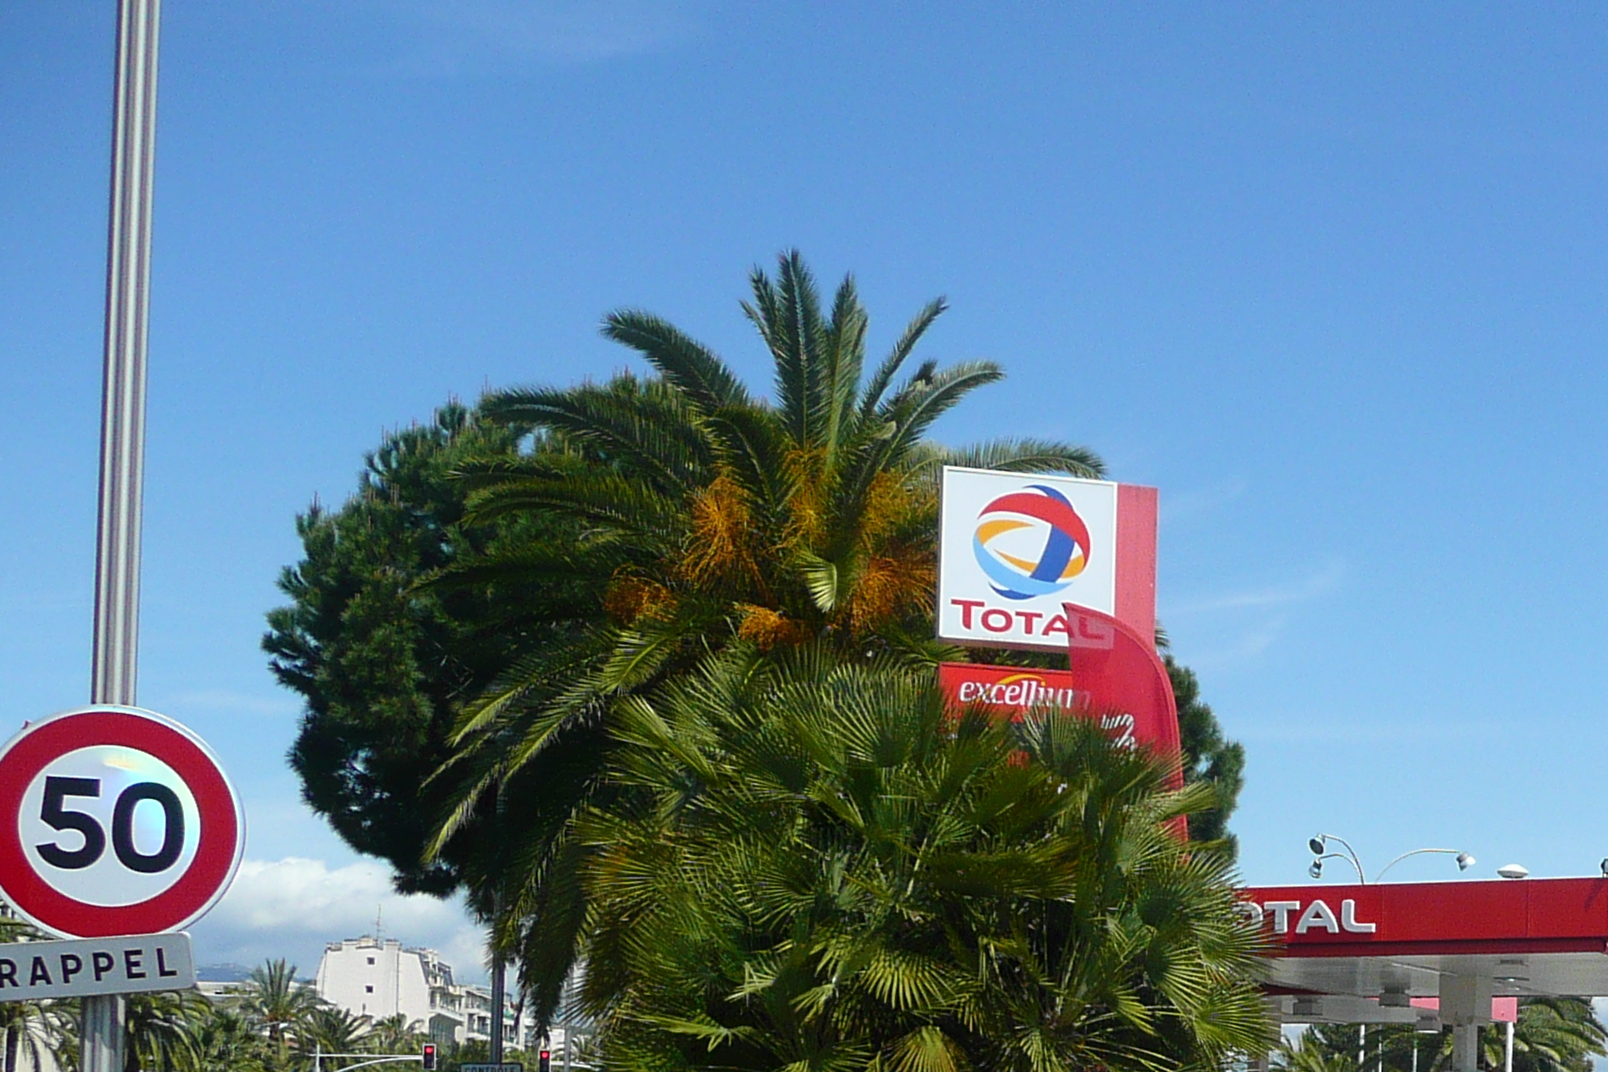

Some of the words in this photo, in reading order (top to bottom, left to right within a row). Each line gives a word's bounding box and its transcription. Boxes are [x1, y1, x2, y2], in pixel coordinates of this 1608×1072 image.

[951, 599, 1105, 641] TOTAL
[959, 678, 1091, 709] excellium
[36, 776, 185, 874] 50
[1232, 899, 1377, 934] OTAL
[0, 948, 178, 989] RAPPEL
